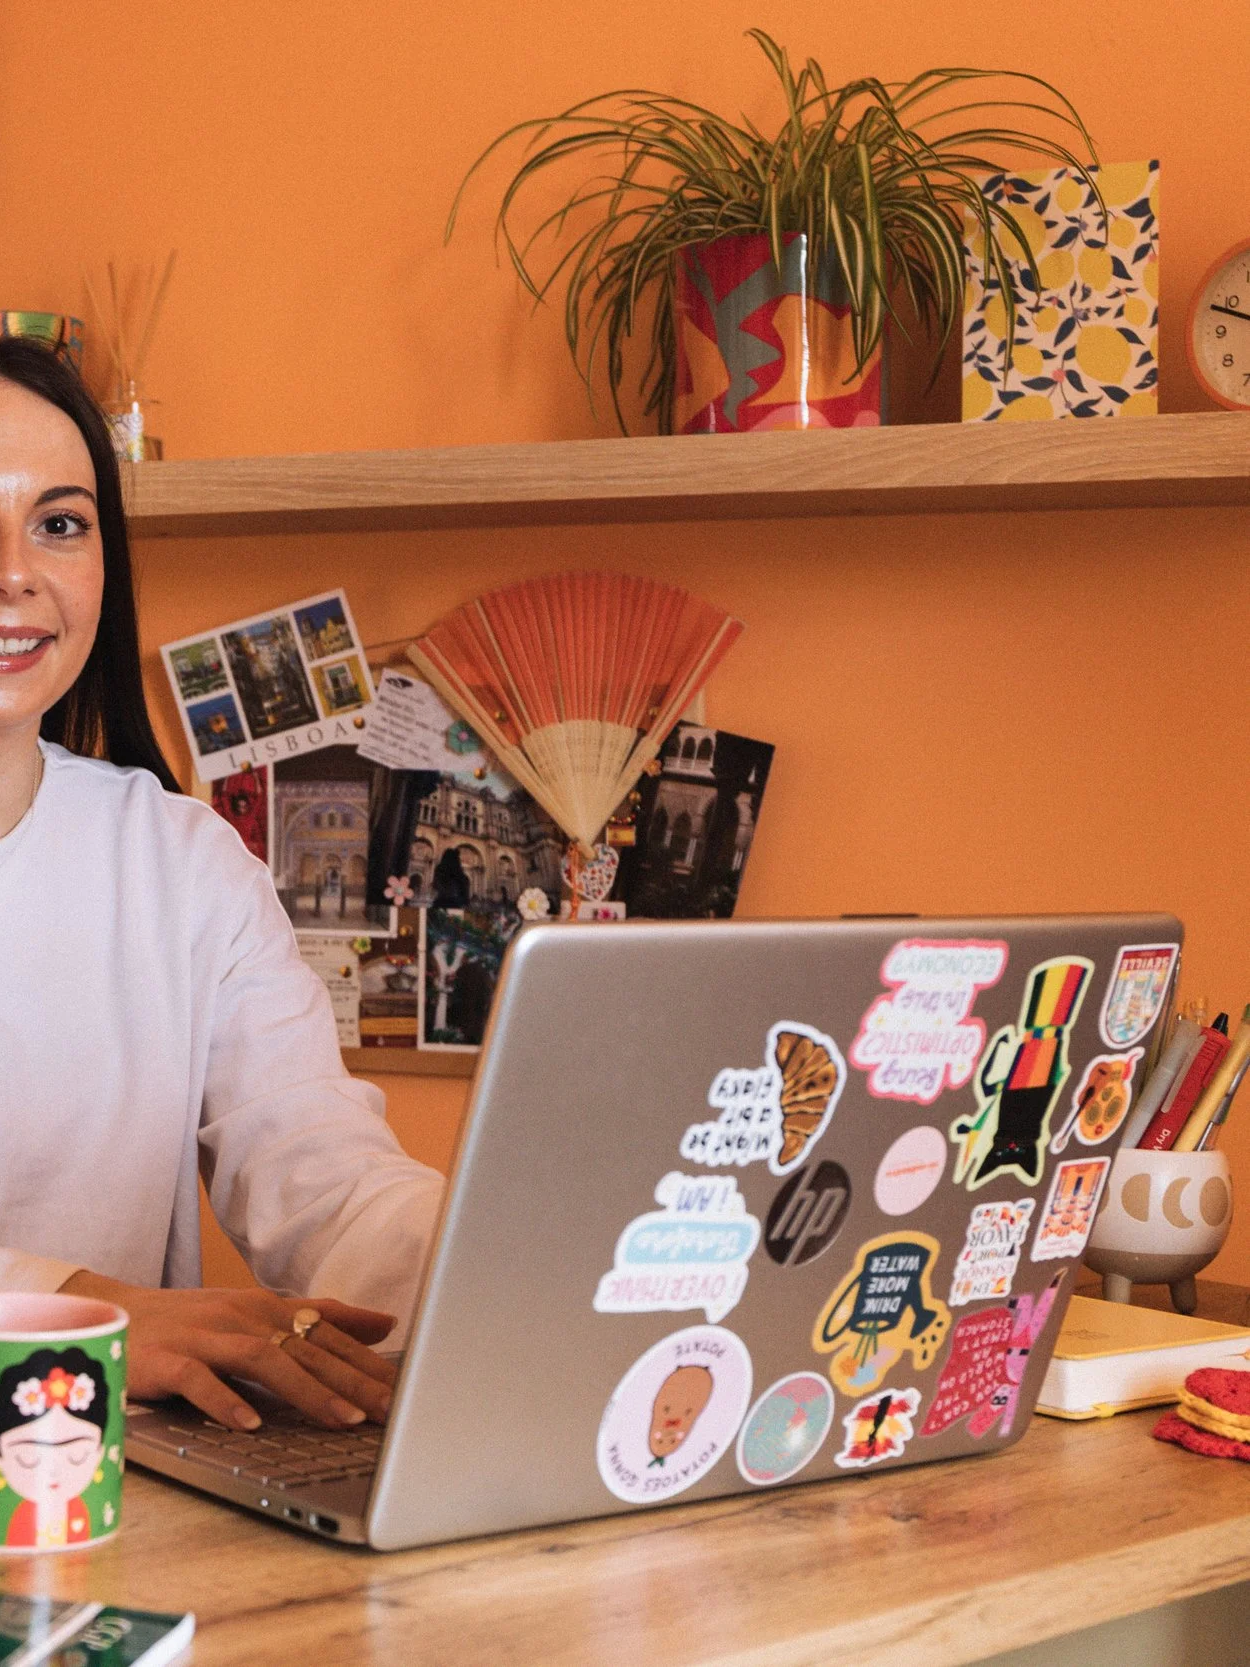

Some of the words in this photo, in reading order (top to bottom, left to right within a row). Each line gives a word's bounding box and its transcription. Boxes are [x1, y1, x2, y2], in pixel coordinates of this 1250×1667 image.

[1225, 294, 1240, 310] 10
[1214, 324, 1227, 339] 9
[1222, 353, 1235, 368] 8
[227, 719, 351, 770] LISBOA
[1121, 956, 1171, 974] SEVILLE
[759, 1107, 772, 1123] a
[1156, 1128, 1172, 1145] Dry
[676, 1185, 716, 1213] AM
[770, 1160, 848, 1268] hp
[968, 1222, 1027, 1250] FAVOR
[870, 1254, 921, 1274] WATER
[865, 1275, 911, 1295] MORE
[861, 1295, 903, 1315] DRINK
[956, 1316, 1011, 1338] STOMACH
[674, 1338, 727, 1359] POTATE
[960, 1327, 1010, 1354] EMPTY
[973, 1346, 992, 1361] AN
[960, 1352, 1006, 1385] WORLD
[969, 1364, 1003, 1395] SAVE
[934, 1391, 961, 1412] THE
[607, 1441, 641, 1489] GONNA
[642, 1441, 718, 1493] POTATOES
